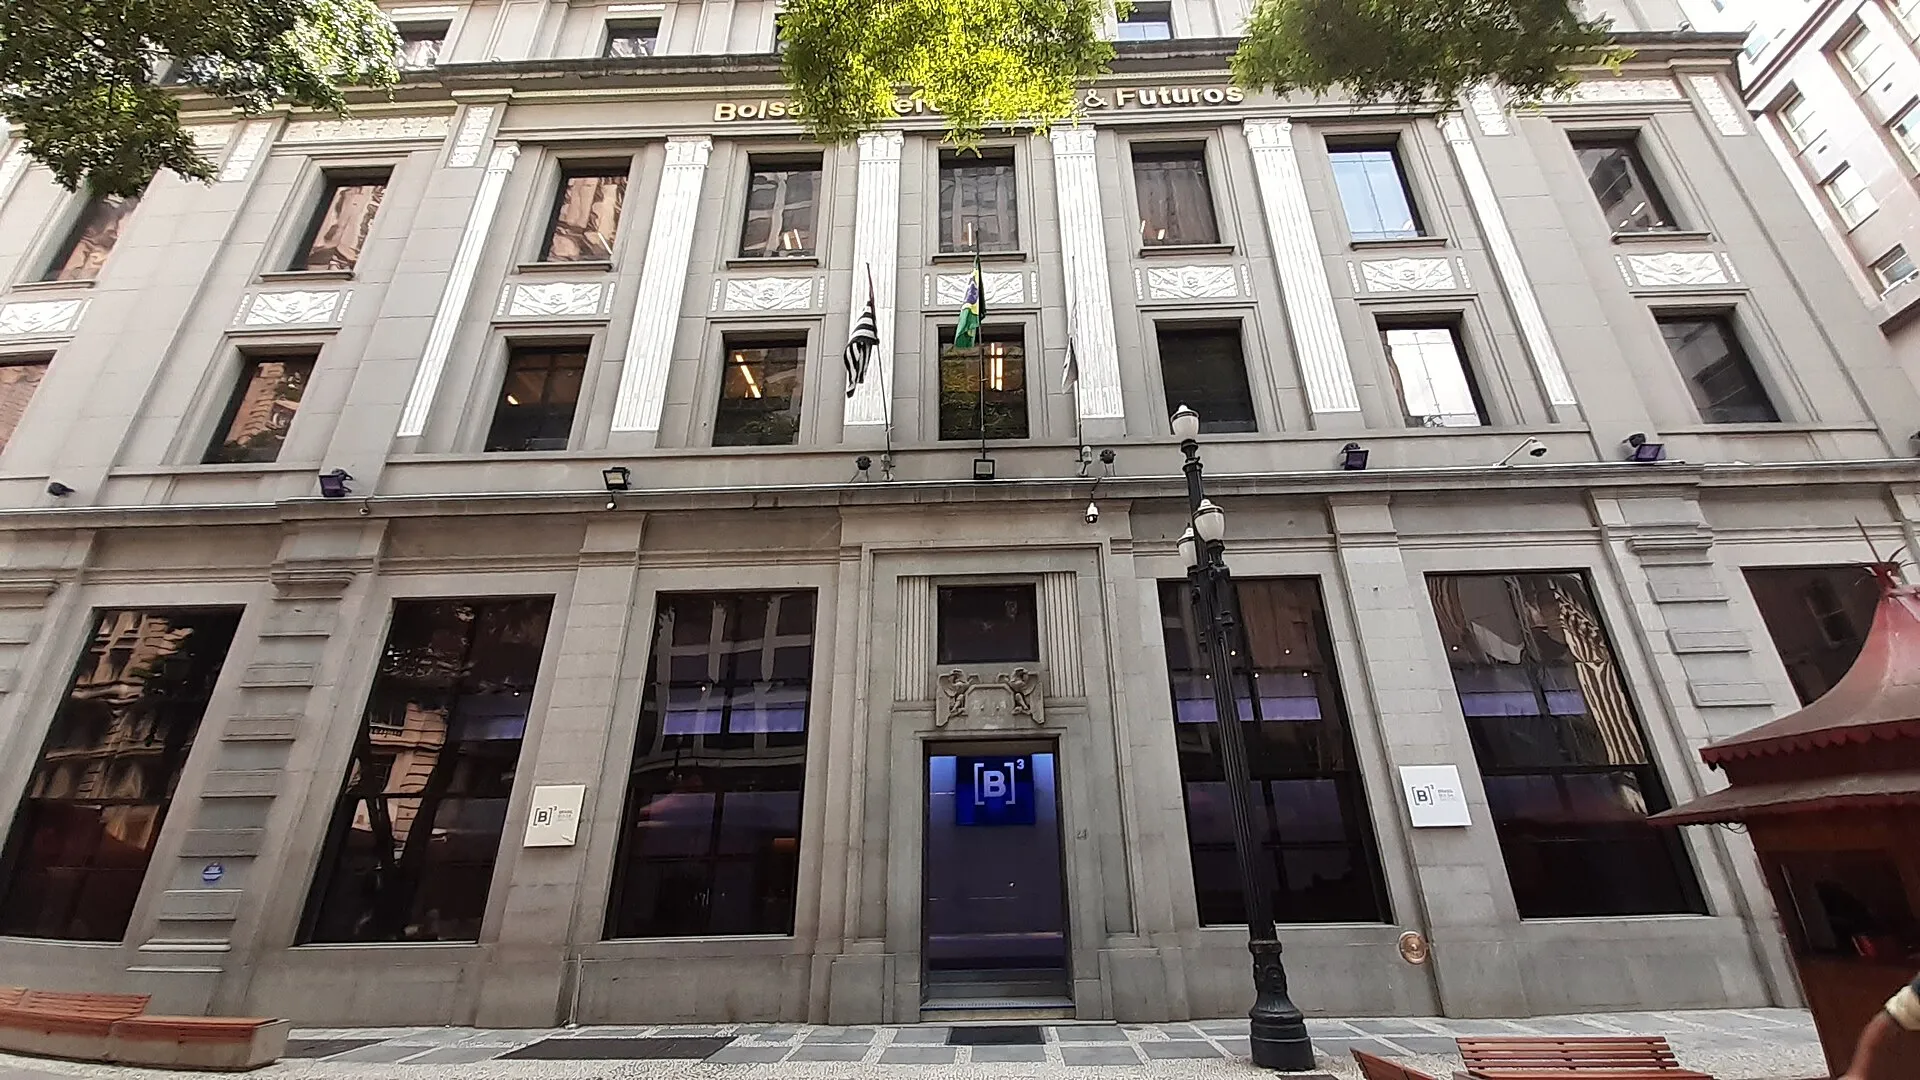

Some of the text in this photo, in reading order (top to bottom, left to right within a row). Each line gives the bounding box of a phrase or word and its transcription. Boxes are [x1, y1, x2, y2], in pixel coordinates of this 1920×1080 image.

[714, 86, 1245, 122] Bolsa & Futuros
